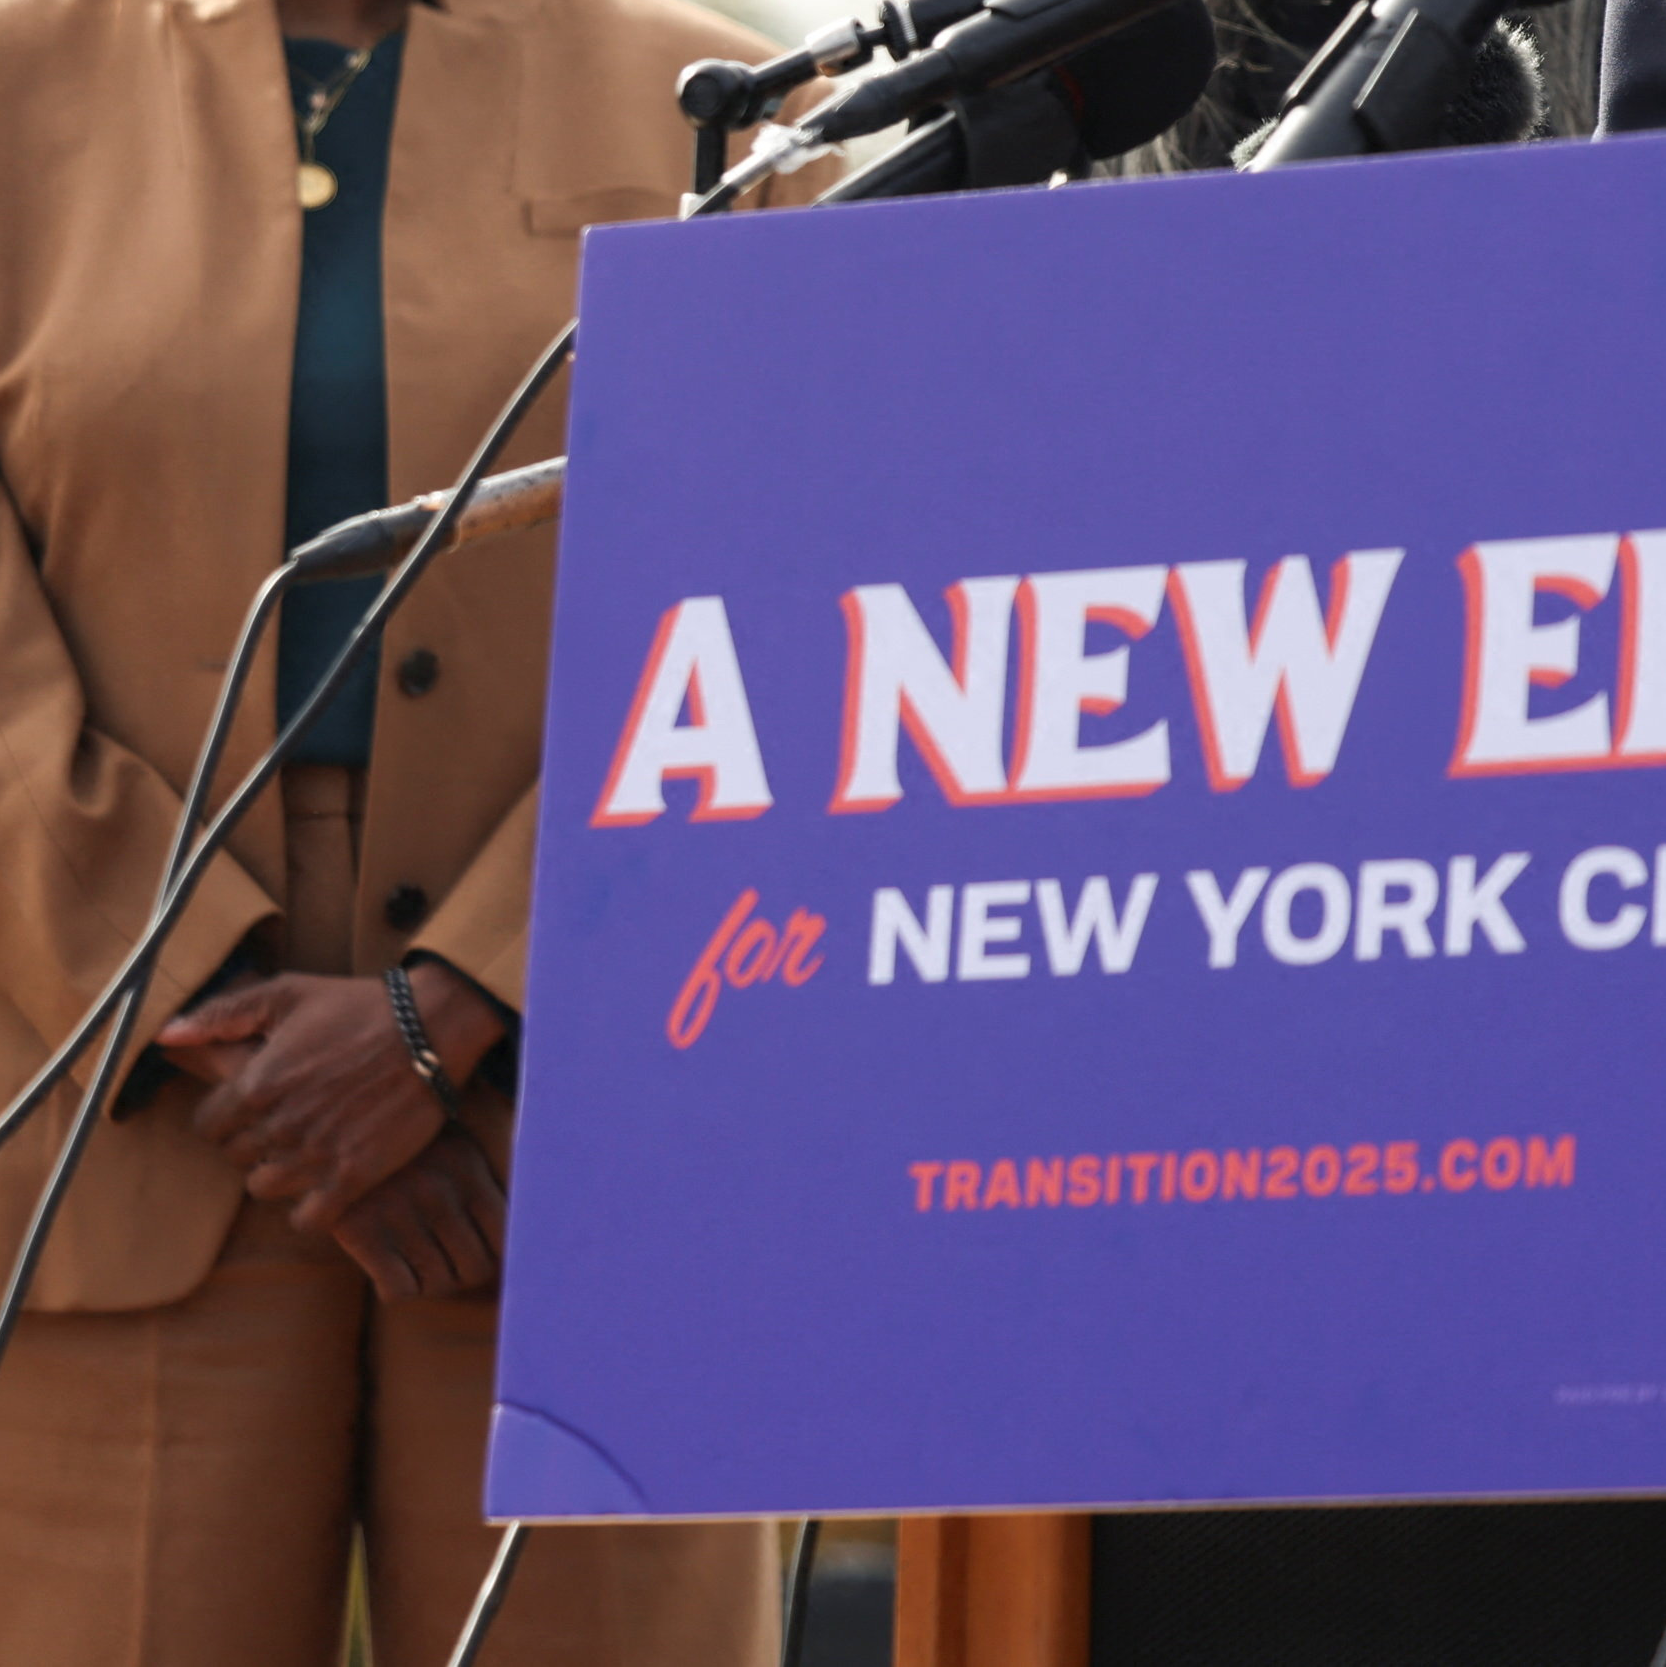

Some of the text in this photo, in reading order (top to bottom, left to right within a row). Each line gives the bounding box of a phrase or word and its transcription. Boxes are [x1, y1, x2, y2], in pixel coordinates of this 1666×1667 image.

[586, 592, 776, 831] A
[823, 545, 1408, 818] NEW
[663, 884, 830, 1053] for
[865, 871, 1161, 989] NEW
[1183, 850, 1533, 972] YORK
[906, 1132, 1579, 1215] TRANSITION2025.COM
